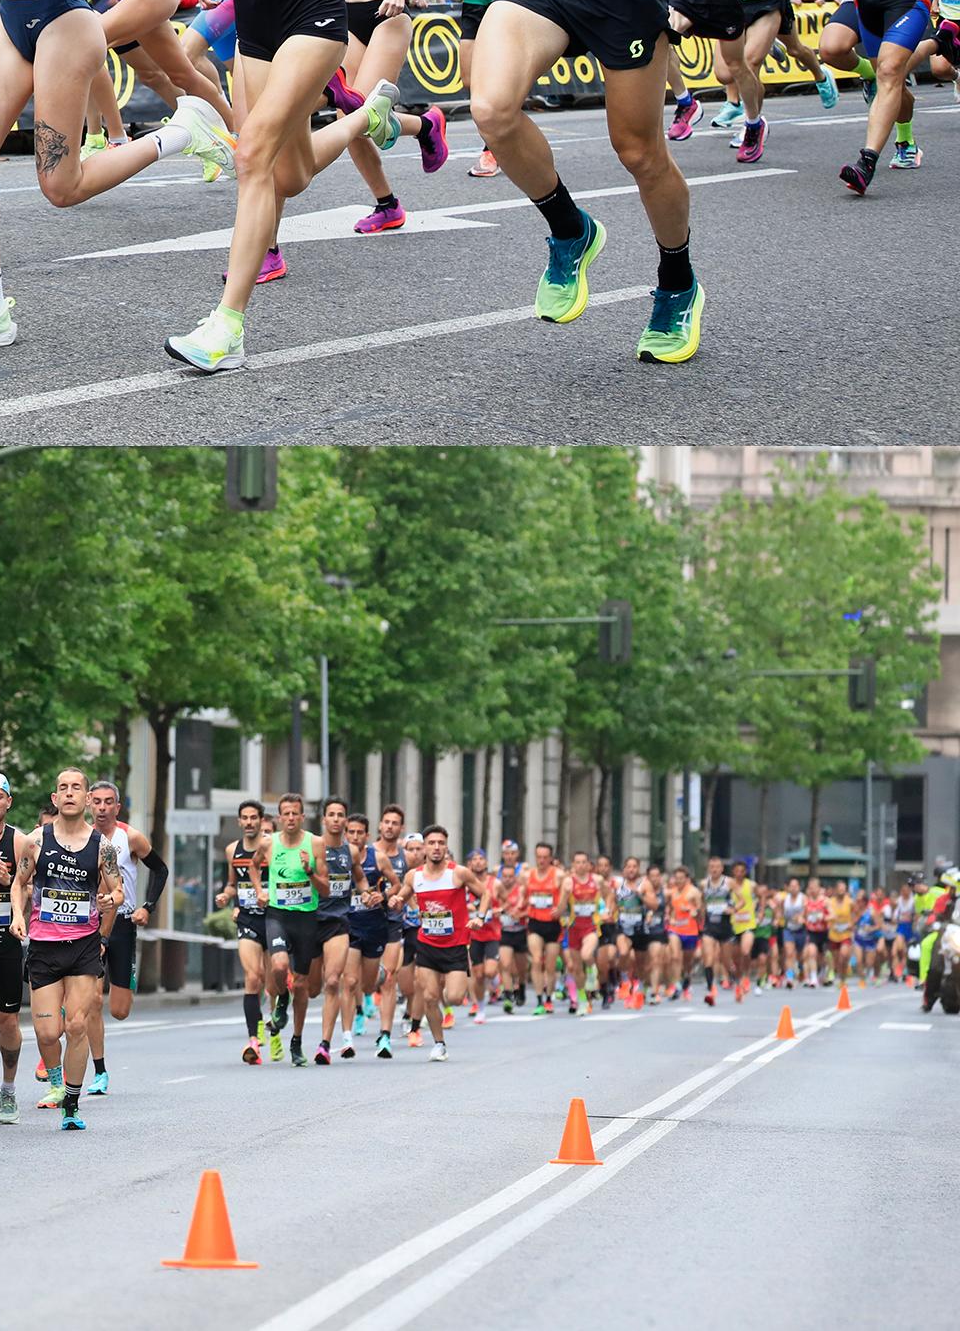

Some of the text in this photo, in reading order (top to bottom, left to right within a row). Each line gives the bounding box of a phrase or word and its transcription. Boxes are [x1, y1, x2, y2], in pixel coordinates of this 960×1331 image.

[48, 862, 55, 870] O
[57, 864, 88, 877] BARCO
[284, 889, 303, 899] 395
[53, 900, 78, 915] 202
[50, 913, 78, 923] Joma
